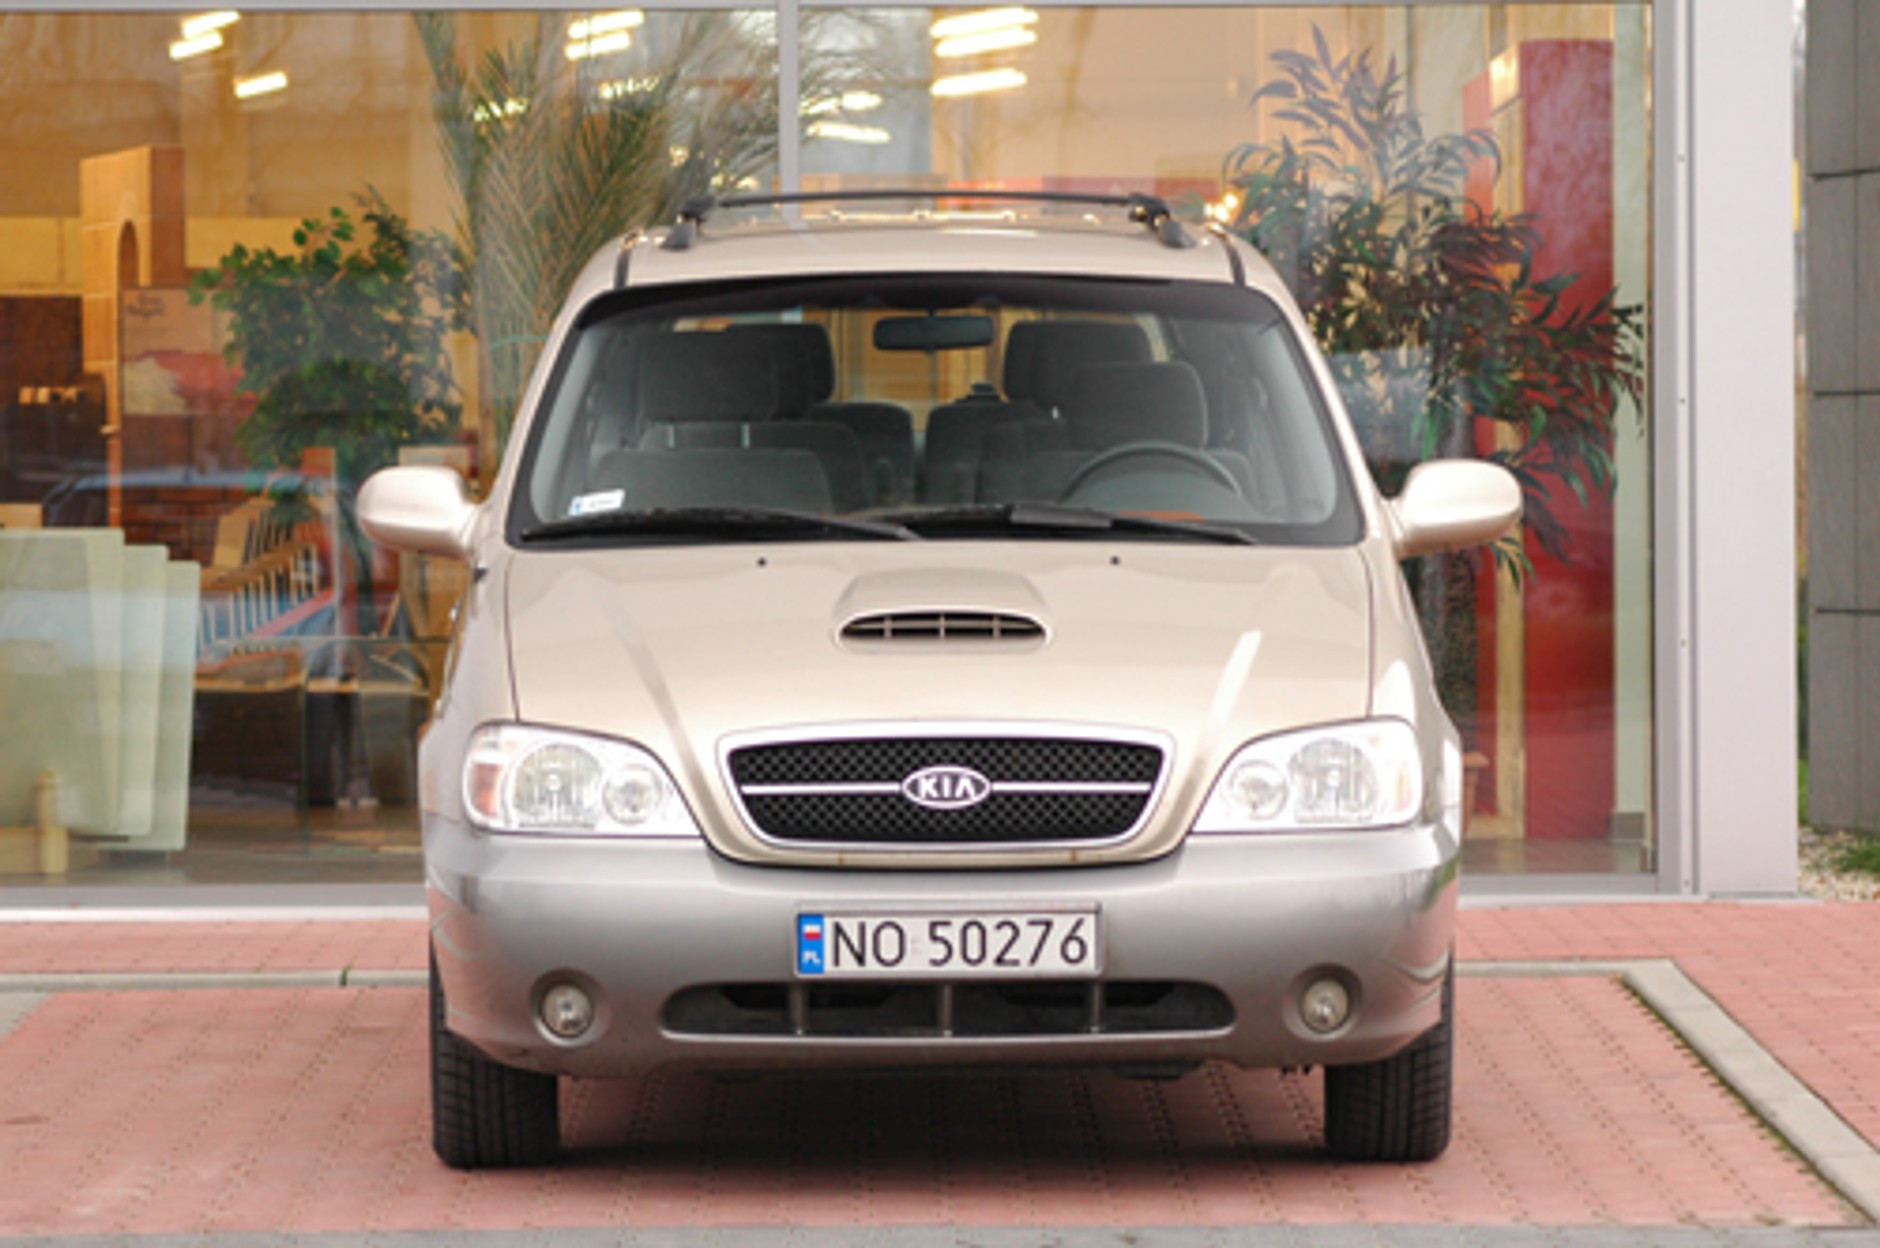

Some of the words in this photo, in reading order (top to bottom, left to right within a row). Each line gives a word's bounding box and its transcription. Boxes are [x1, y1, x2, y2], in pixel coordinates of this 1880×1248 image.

[918, 775, 976, 799] KIA
[832, 919, 906, 967] NO
[928, 917, 1090, 967] 50276
[802, 950, 821, 965] PL
